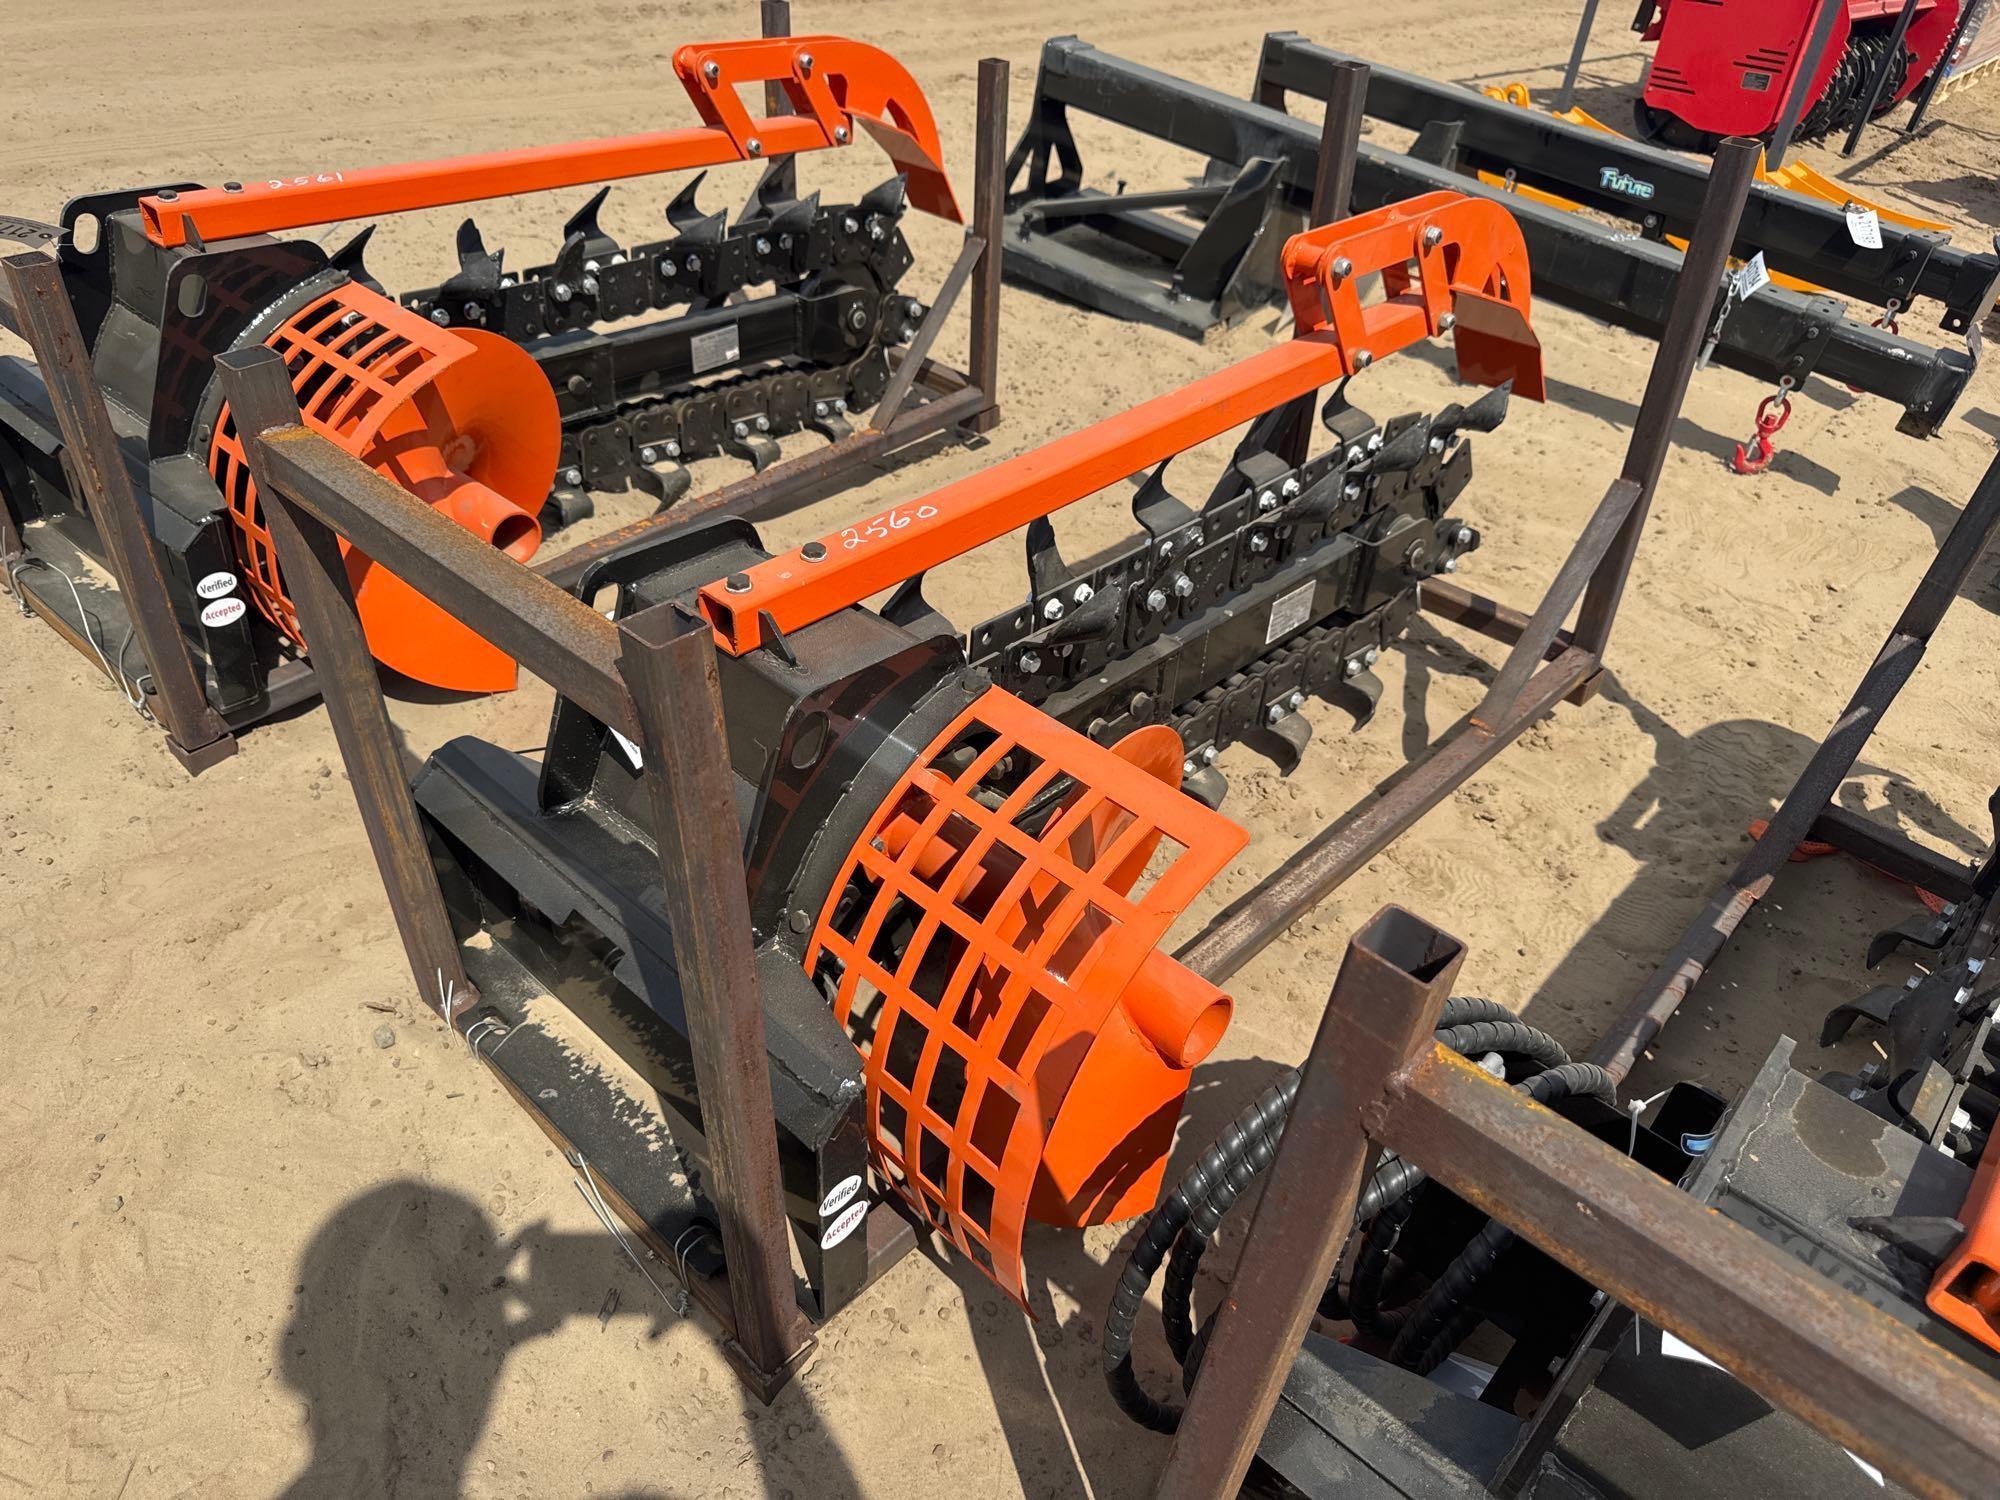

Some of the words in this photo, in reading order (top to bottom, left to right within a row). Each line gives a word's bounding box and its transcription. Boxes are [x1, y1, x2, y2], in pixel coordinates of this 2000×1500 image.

[268, 172, 344, 190] 2561
[1601, 169, 1653, 199] Future
[0, 222, 38, 238] 217
[840, 505, 939, 549] 2560
[200, 576, 234, 594] Verified
[205, 602, 242, 621] Accepted
[823, 1179, 859, 1211] Verified
[825, 1203, 865, 1243] Accepted
